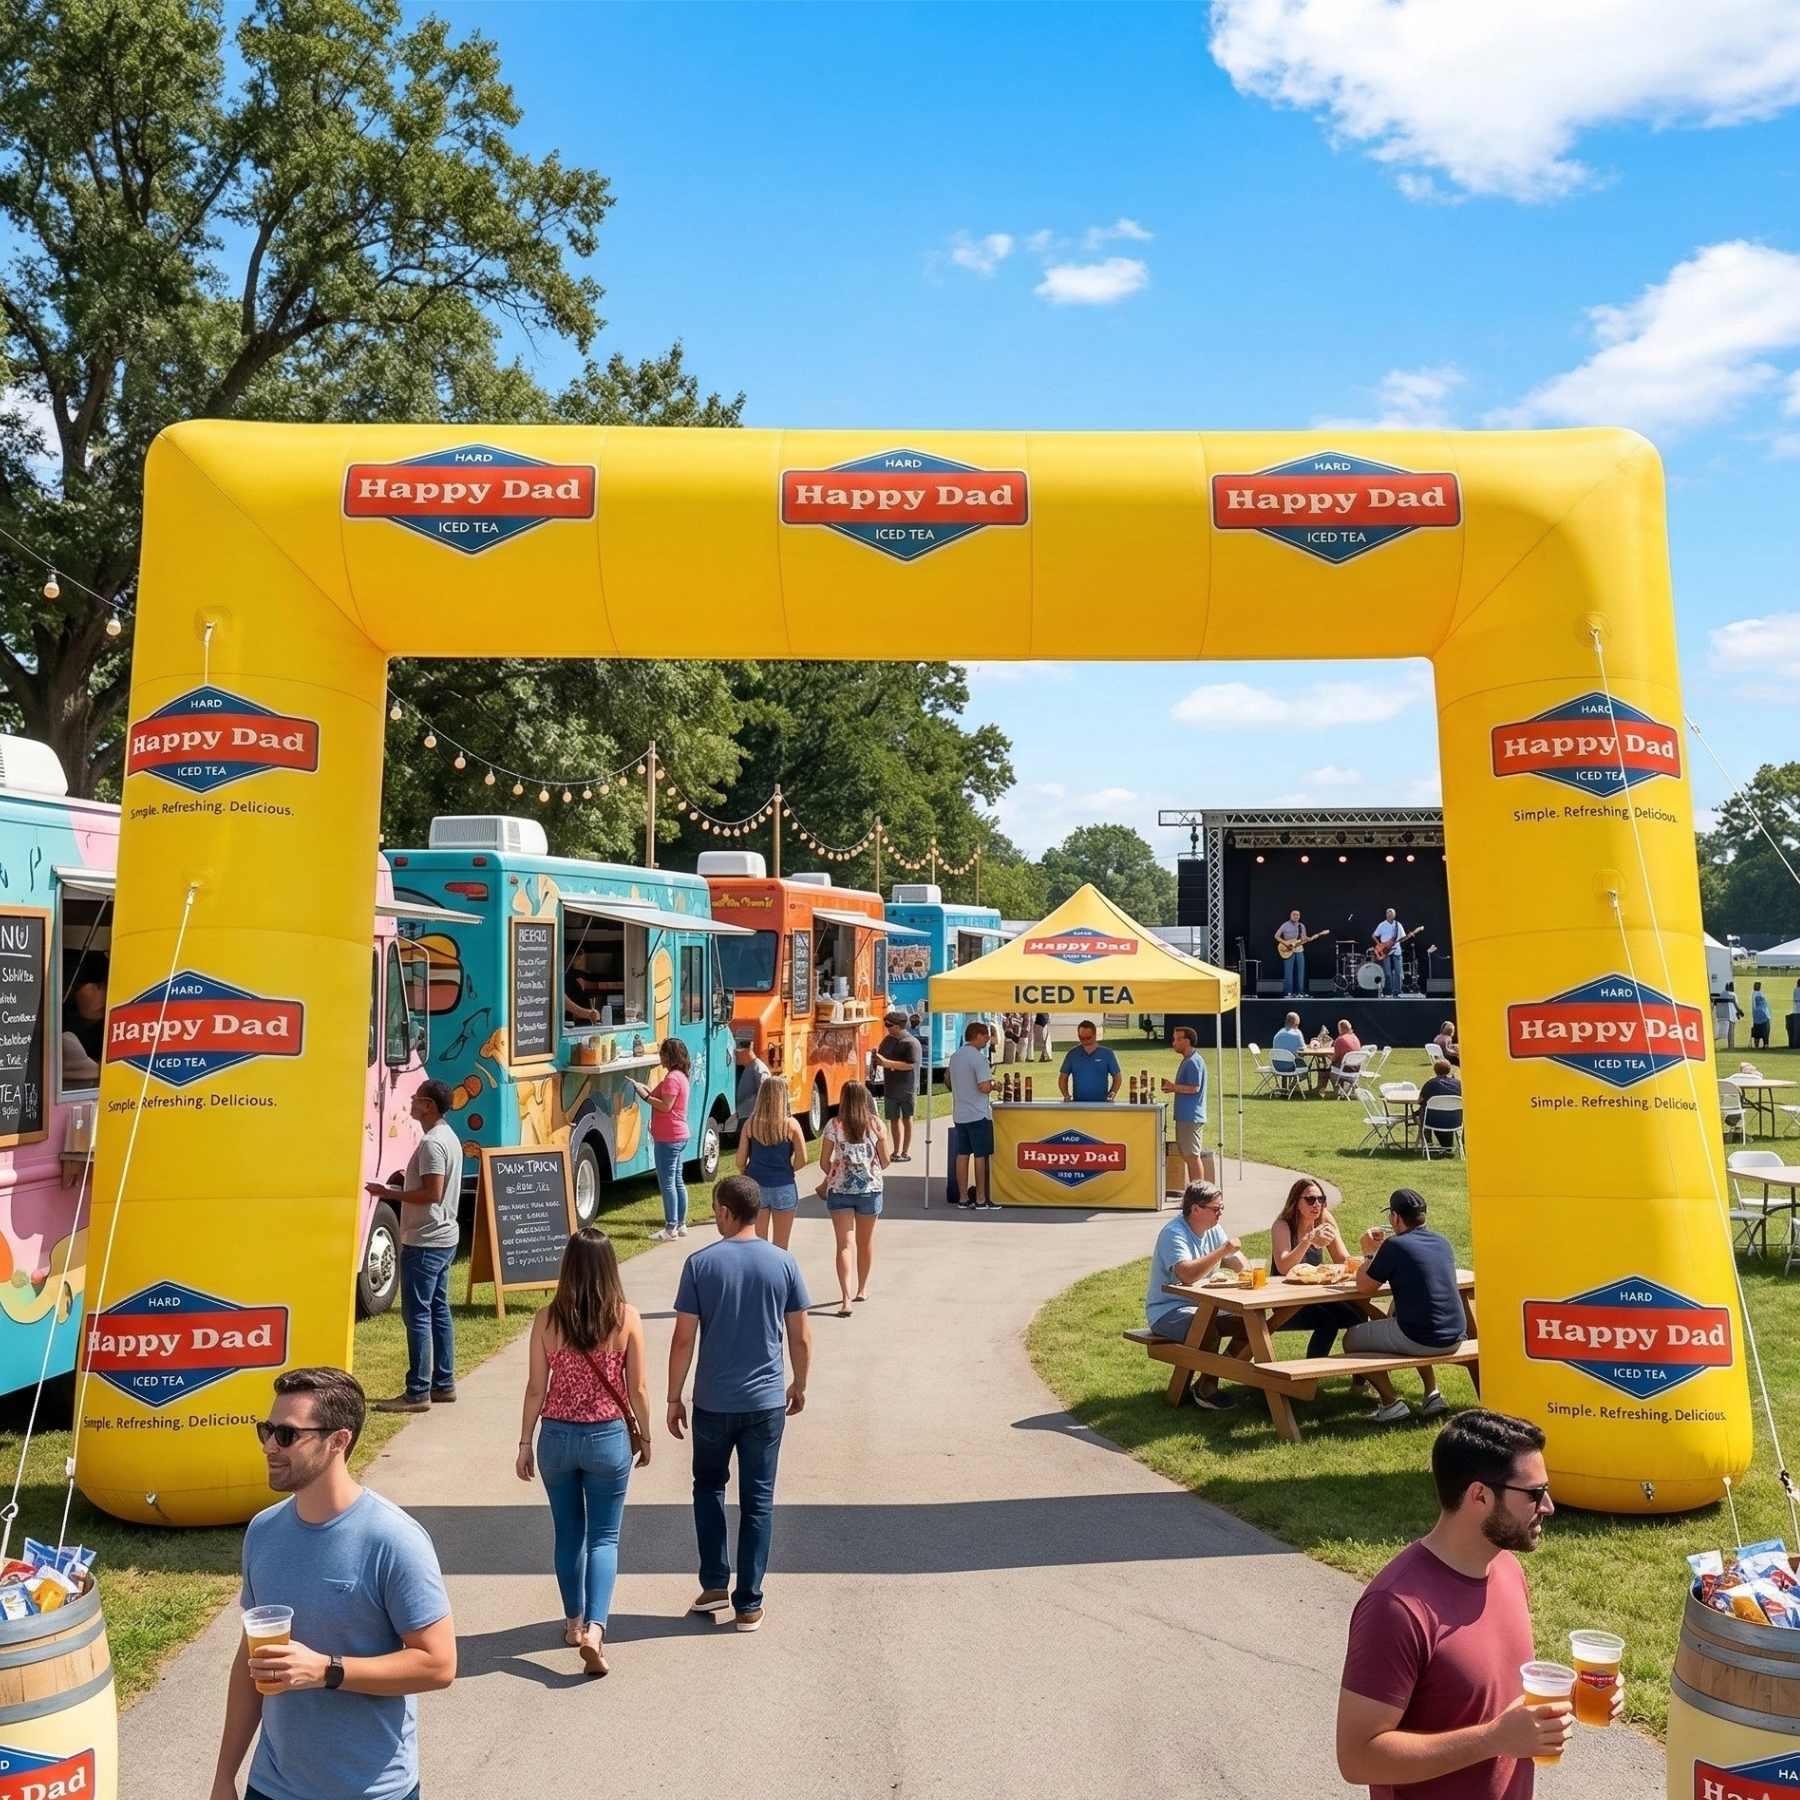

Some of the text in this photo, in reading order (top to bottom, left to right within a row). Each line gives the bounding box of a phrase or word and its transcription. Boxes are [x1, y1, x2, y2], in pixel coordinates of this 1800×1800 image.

[455, 453, 493, 463] HARD
[885, 460, 922, 468] HARD
[1314, 462, 1351, 471] HARD
[357, 478, 581, 504] Happy Dad
[795, 485, 1014, 511] Happy Dad
[1225, 486, 1446, 514] Happy Dad
[438, 522, 499, 533] ICED TEA
[876, 529, 935, 540] ICED TEA
[1307, 532, 1367, 543] ICED TEA
[190, 699, 223, 708] HARD
[132, 727, 305, 757] Happy Dad
[1503, 734, 1675, 759] Happy Dad
[177, 766, 227, 777] ICED TEA
[1576, 771, 1626, 781] ICED TEA
[162, 800, 225, 814] Refreshing.
[230, 801, 294, 816] Delicious.
[1513, 807, 1559, 822] Simple.
[1564, 805, 1629, 820] Refreshing
[1095, 942, 1131, 950] Dad
[170, 985, 203, 995] HARD
[1015, 985, 1134, 1004] ICED TEA
[1601, 988, 1633, 998] HARD
[111, 1014, 289, 1044] Happy Dad
[1519, 1018, 1699, 1043] Happy Dad
[156, 1057, 207, 1068] ICED TEA
[1594, 1059, 1646, 1069] ICED TEA
[141, 1095, 206, 1109] Refreshing.
[210, 1094, 277, 1106] Delicious.
[1530, 1095, 1578, 1110] Simple.
[1581, 1095, 1652, 1110] Refreshing.
[1023, 1150, 1120, 1165] Happy Dad
[148, 1297, 181, 1307] HARD
[1620, 1291, 1652, 1302] HARD
[87, 1324, 273, 1357] Happy Dad
[1536, 1318, 1725, 1351] Happy Dad
[1614, 1368, 1667, 1380] ICED TEA
[133, 1376, 184, 1387] ICED TEA
[1547, 1402, 1727, 1423] Simple. Refreshing. Delicious.
[116, 1416, 184, 1431] Refreshing.
